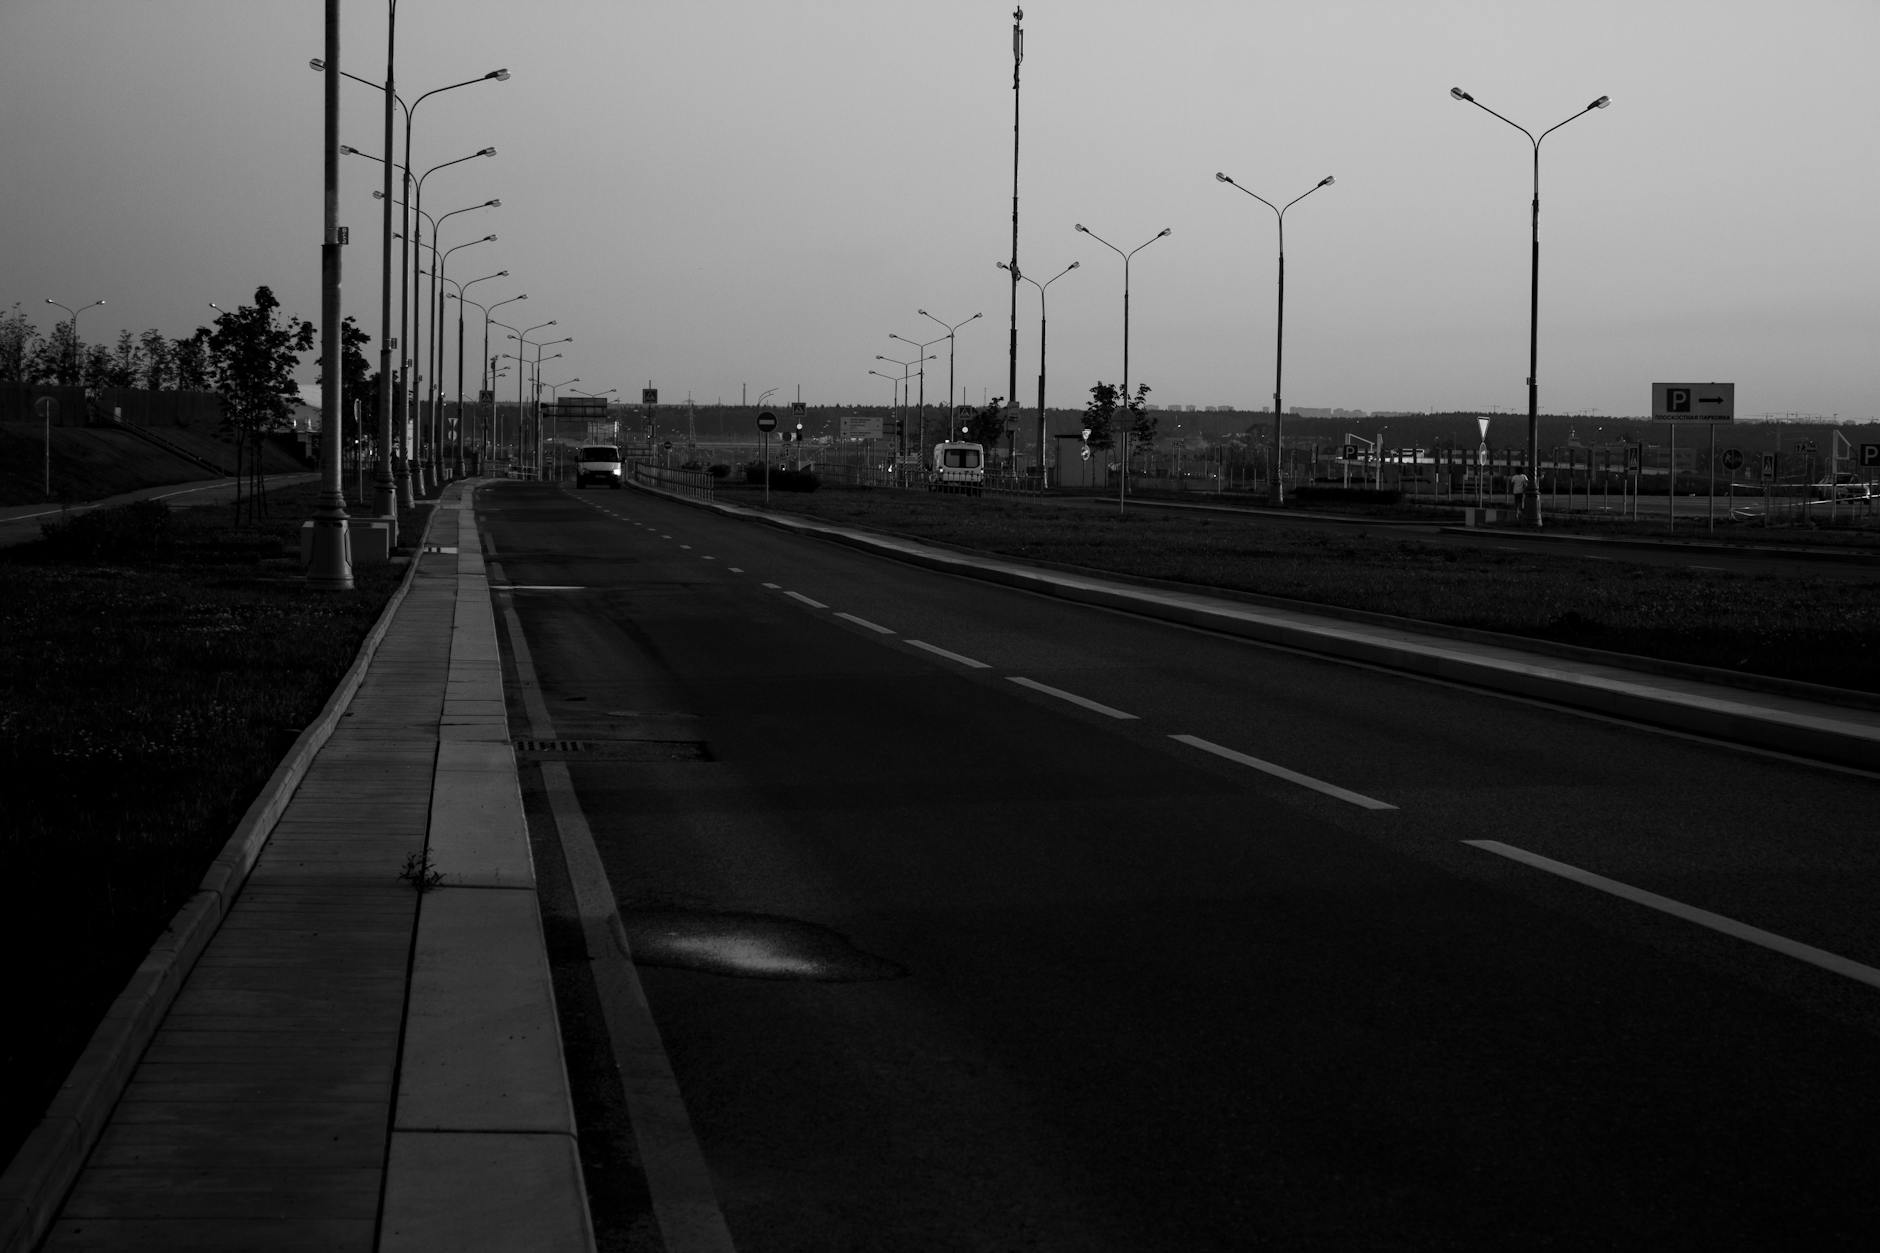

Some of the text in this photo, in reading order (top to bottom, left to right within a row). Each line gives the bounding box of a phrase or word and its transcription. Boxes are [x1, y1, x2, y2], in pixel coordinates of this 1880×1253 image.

[1673, 391, 1687, 411] P
[1346, 446, 1355, 458] P
[1865, 446, 1879, 464] P
